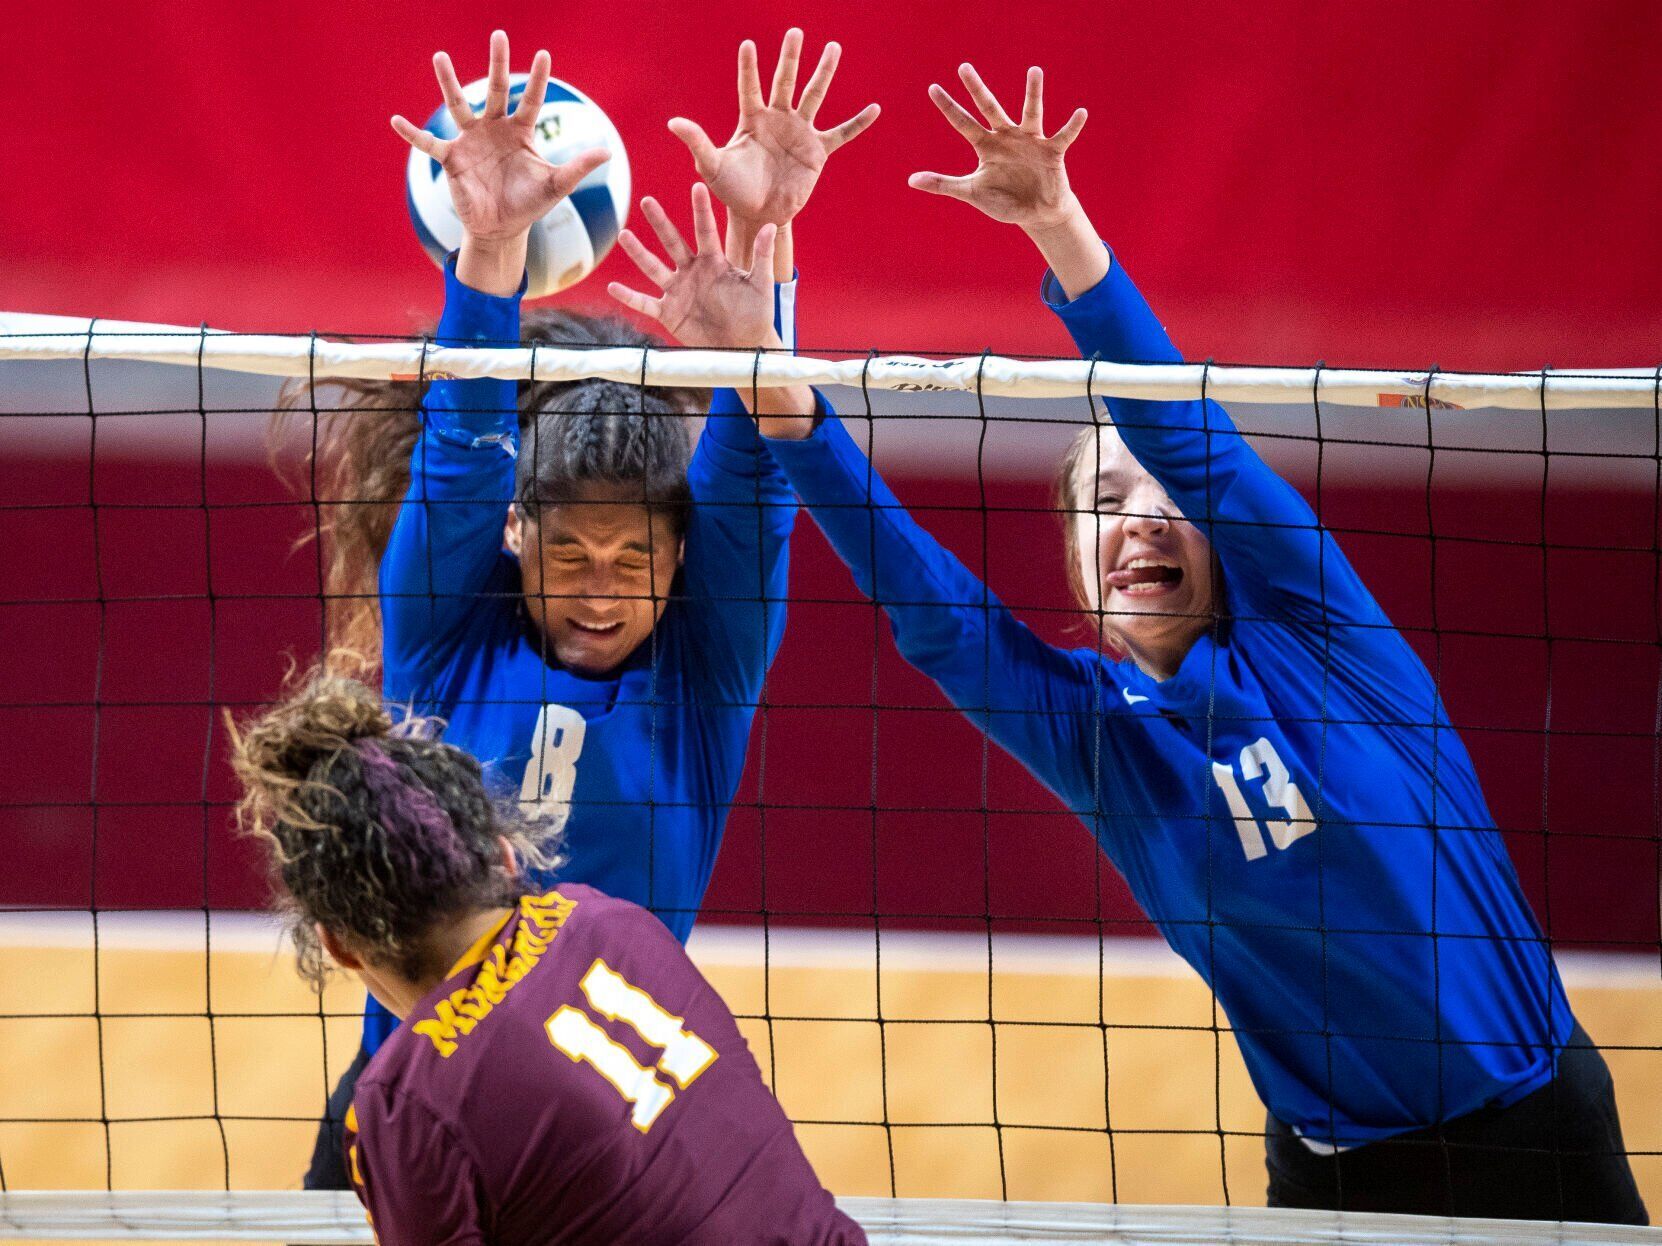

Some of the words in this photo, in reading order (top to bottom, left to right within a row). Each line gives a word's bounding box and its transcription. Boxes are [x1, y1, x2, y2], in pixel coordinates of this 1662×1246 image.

[519, 703, 587, 834] 8
[1212, 736, 1317, 862] 13
[544, 958, 720, 1134] 11
